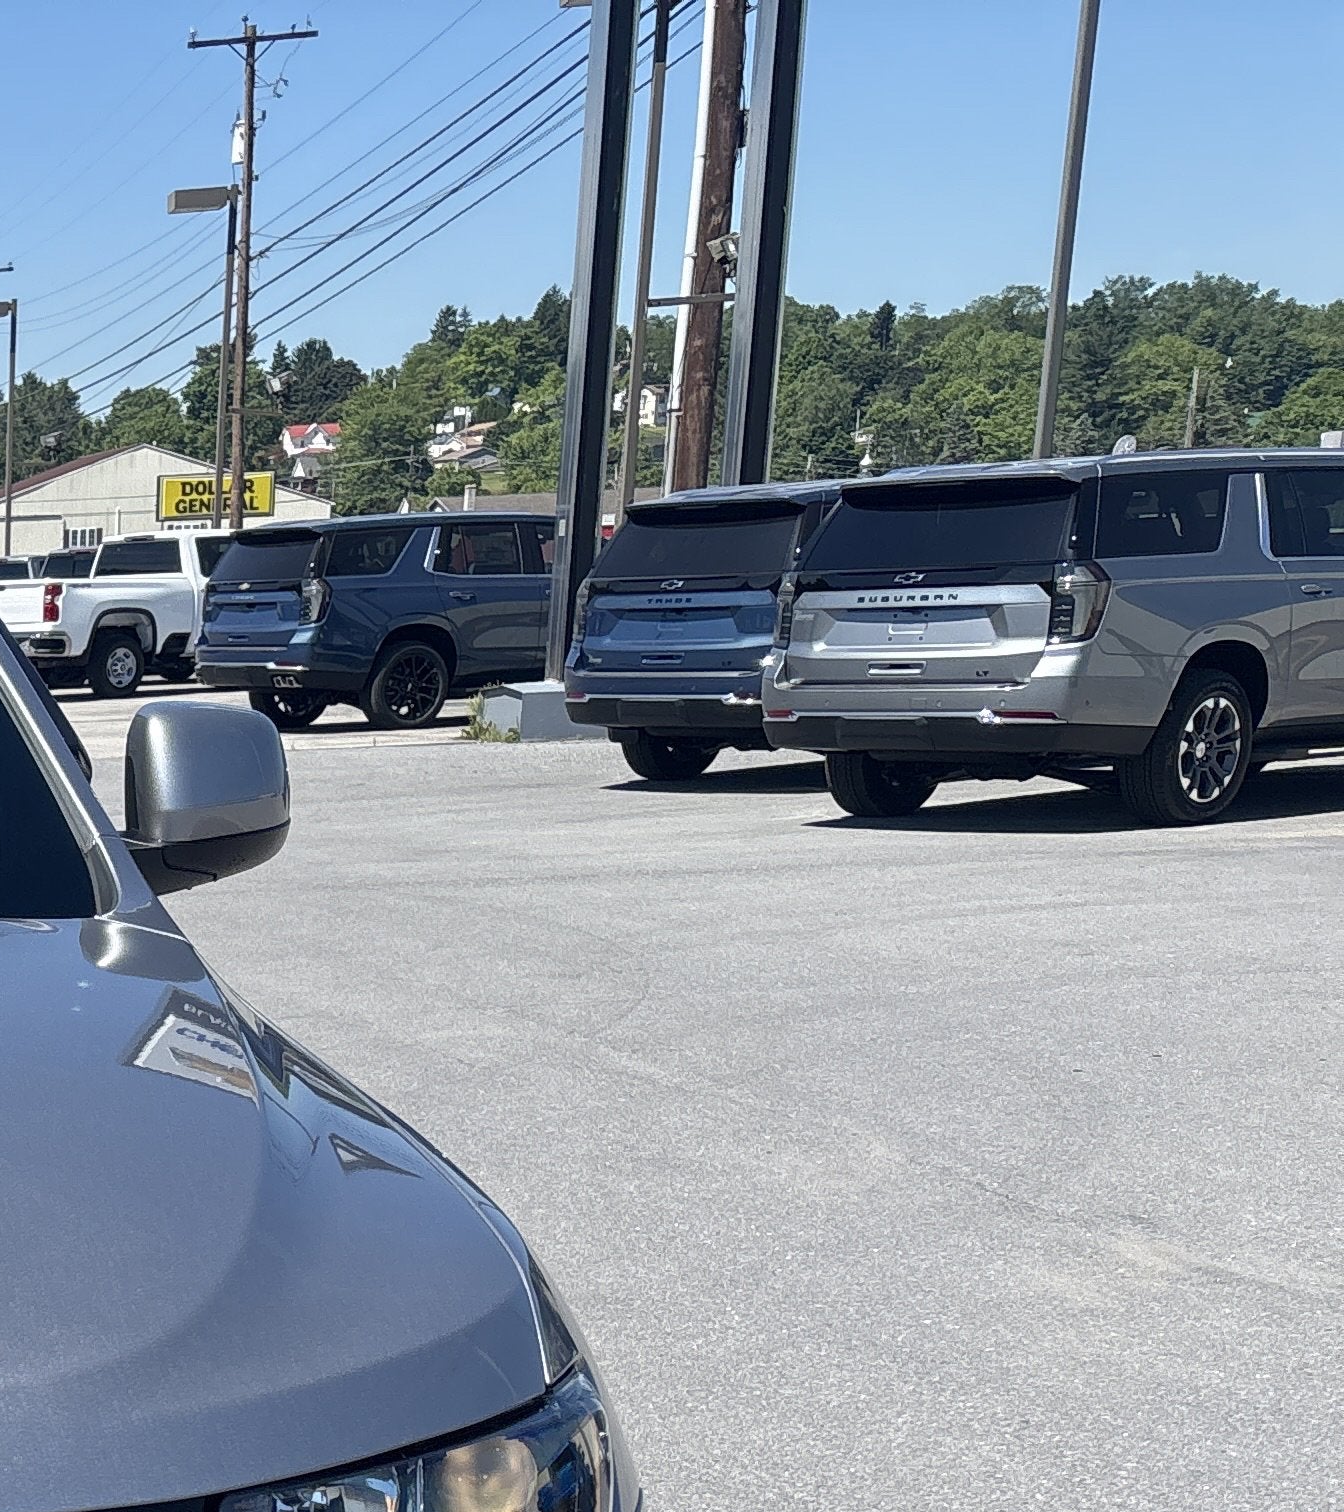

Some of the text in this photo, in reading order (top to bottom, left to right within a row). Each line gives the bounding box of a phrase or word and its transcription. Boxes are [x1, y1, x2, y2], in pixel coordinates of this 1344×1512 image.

[180, 478, 256, 497] DOLR
[174, 496, 260, 514] GENRL
[856, 593, 959, 604] SUBURBAN
[975, 670, 990, 678] LT
